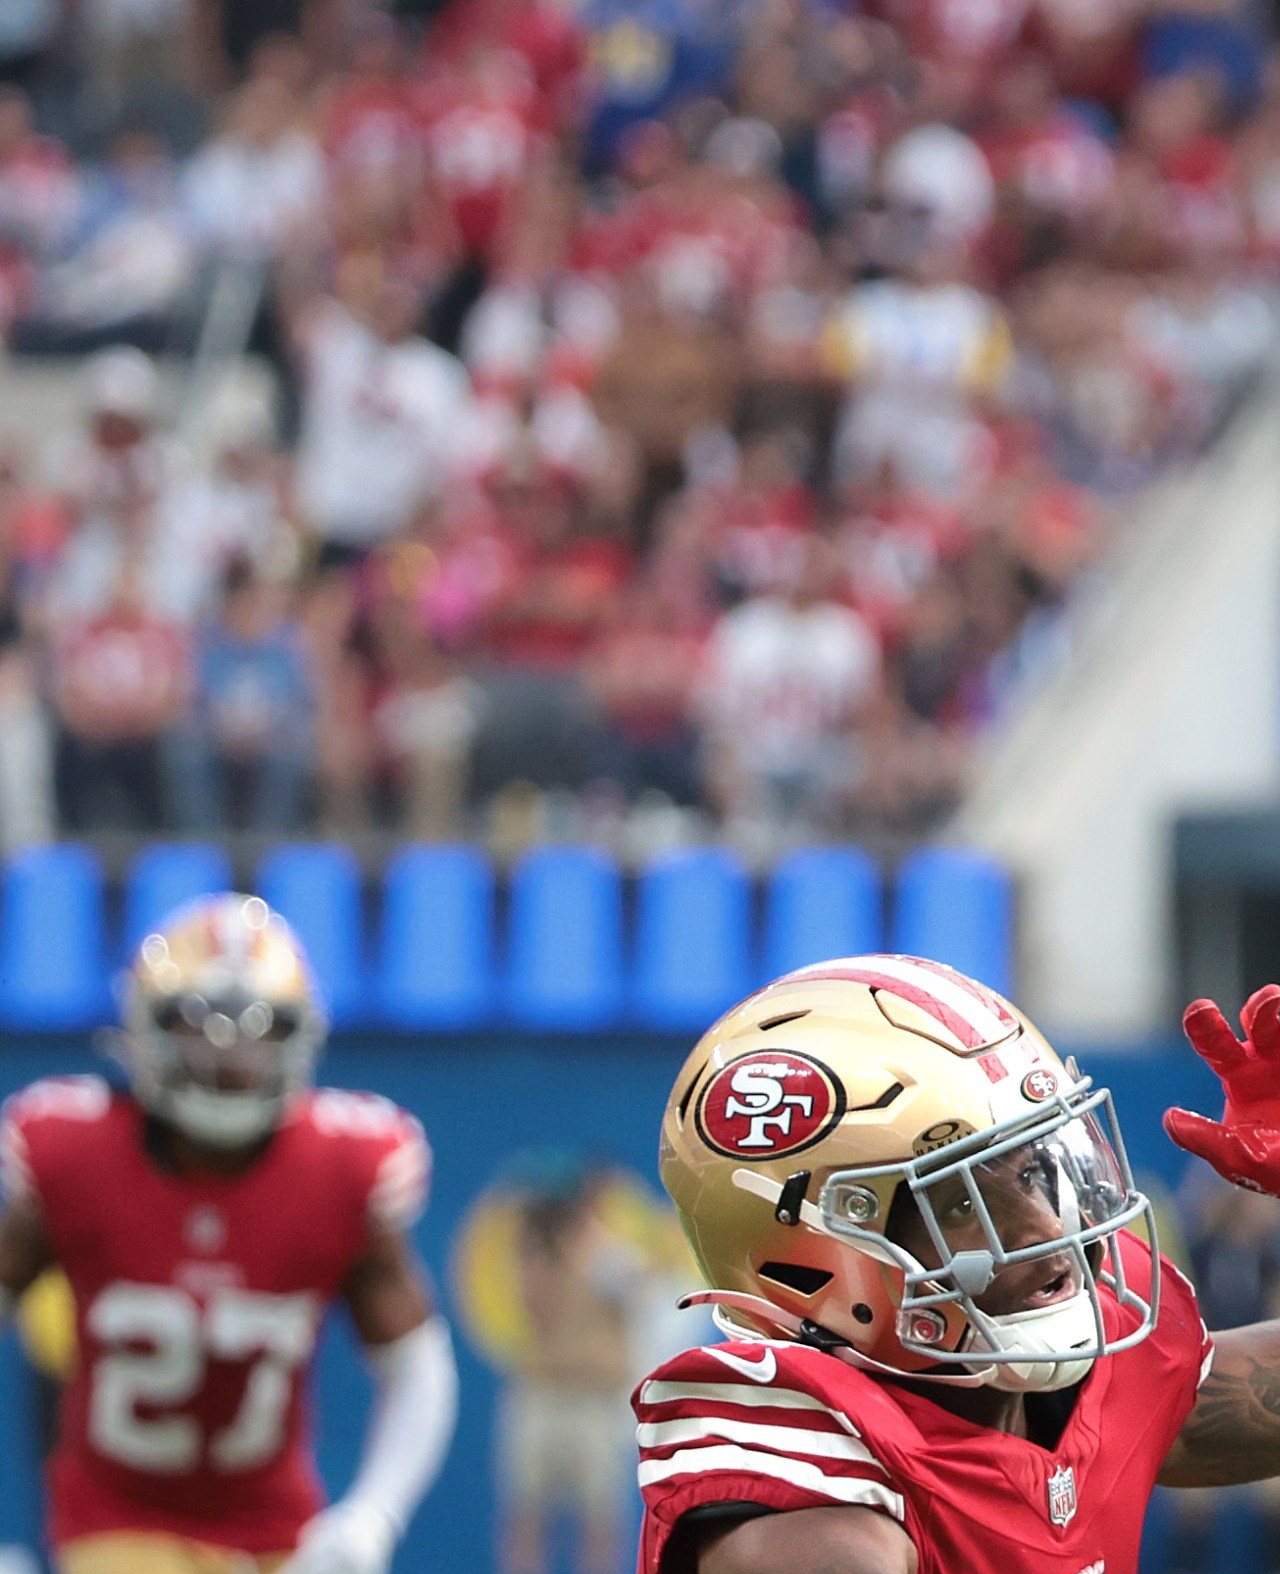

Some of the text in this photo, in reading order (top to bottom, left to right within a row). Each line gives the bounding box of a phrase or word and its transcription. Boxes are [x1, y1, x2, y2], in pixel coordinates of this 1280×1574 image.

[725, 1062, 813, 1149] SF
[86, 1280, 316, 1474] 27
[1055, 1492, 1075, 1516] NFL
